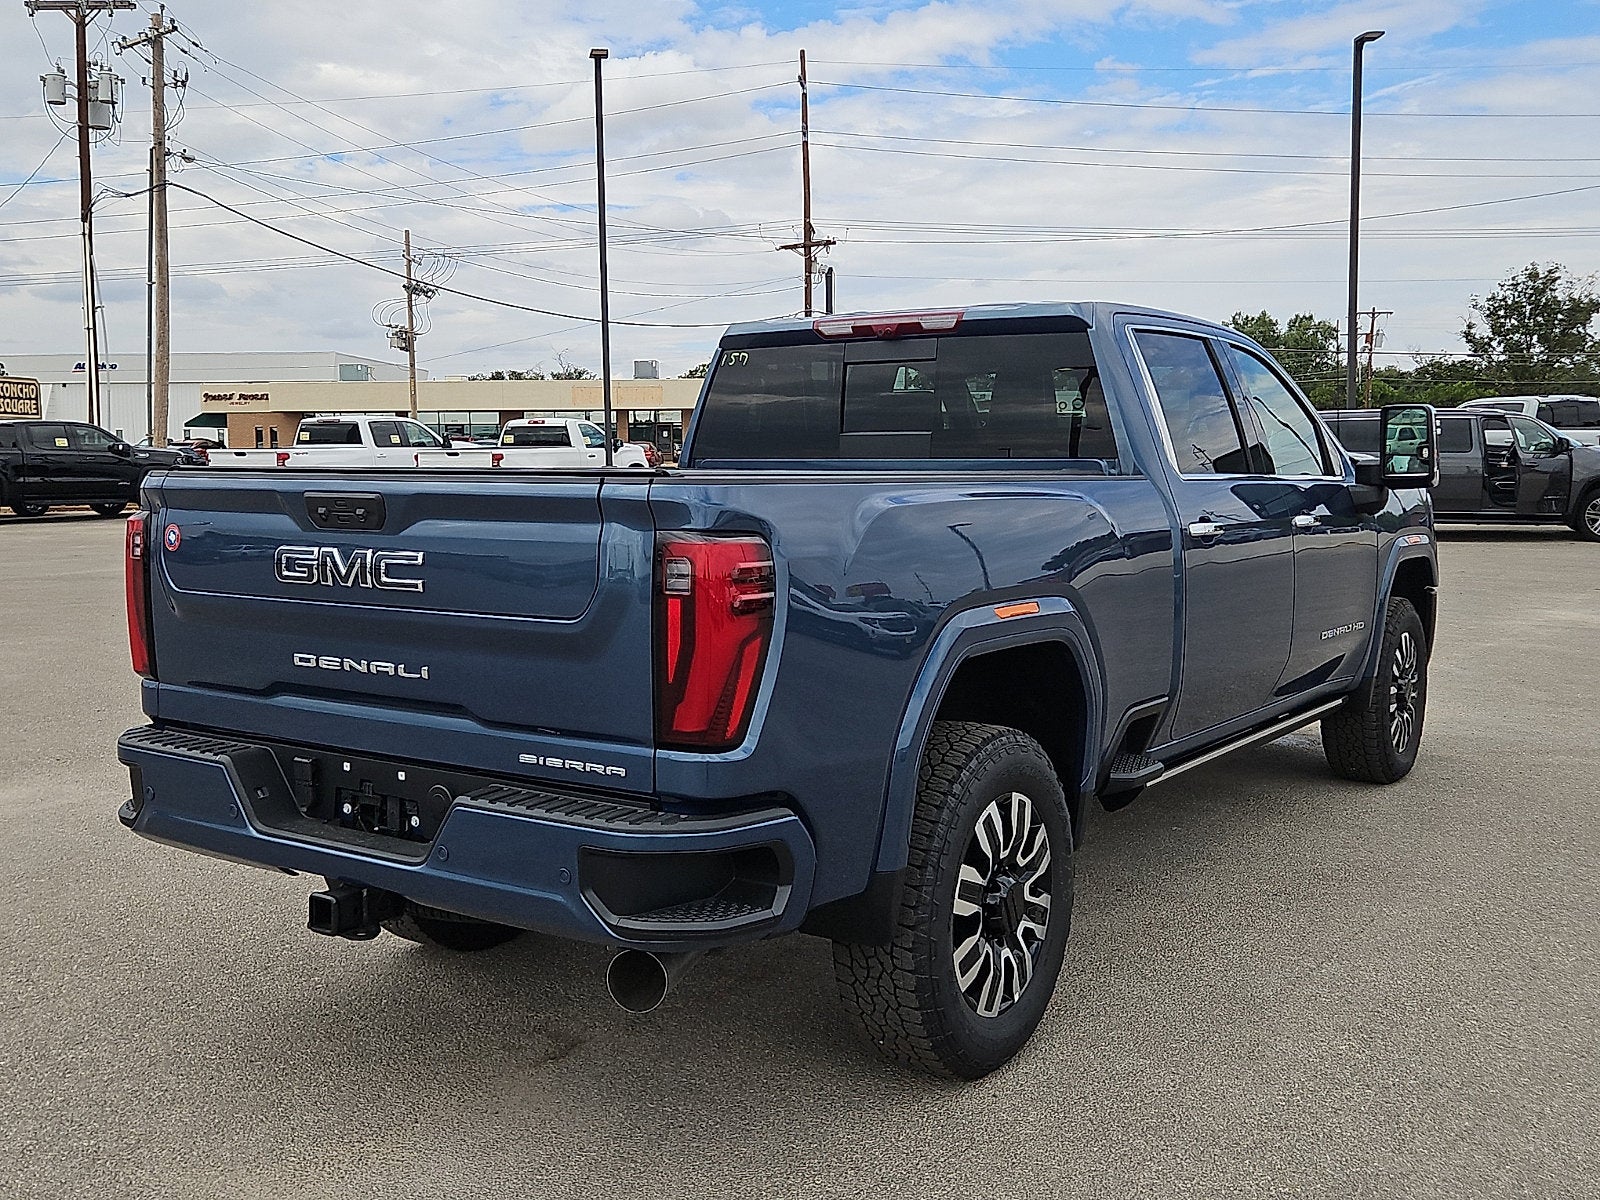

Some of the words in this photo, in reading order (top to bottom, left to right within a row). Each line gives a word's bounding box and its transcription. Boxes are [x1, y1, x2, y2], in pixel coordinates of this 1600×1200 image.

[0, 382, 37, 399] CONCHO
[0, 398, 38, 414] SQUARE
[274, 545, 425, 593] GMC
[1352, 621, 1365, 632] HD
[293, 652, 430, 680] DENALI
[518, 753, 627, 777] SIERRA
